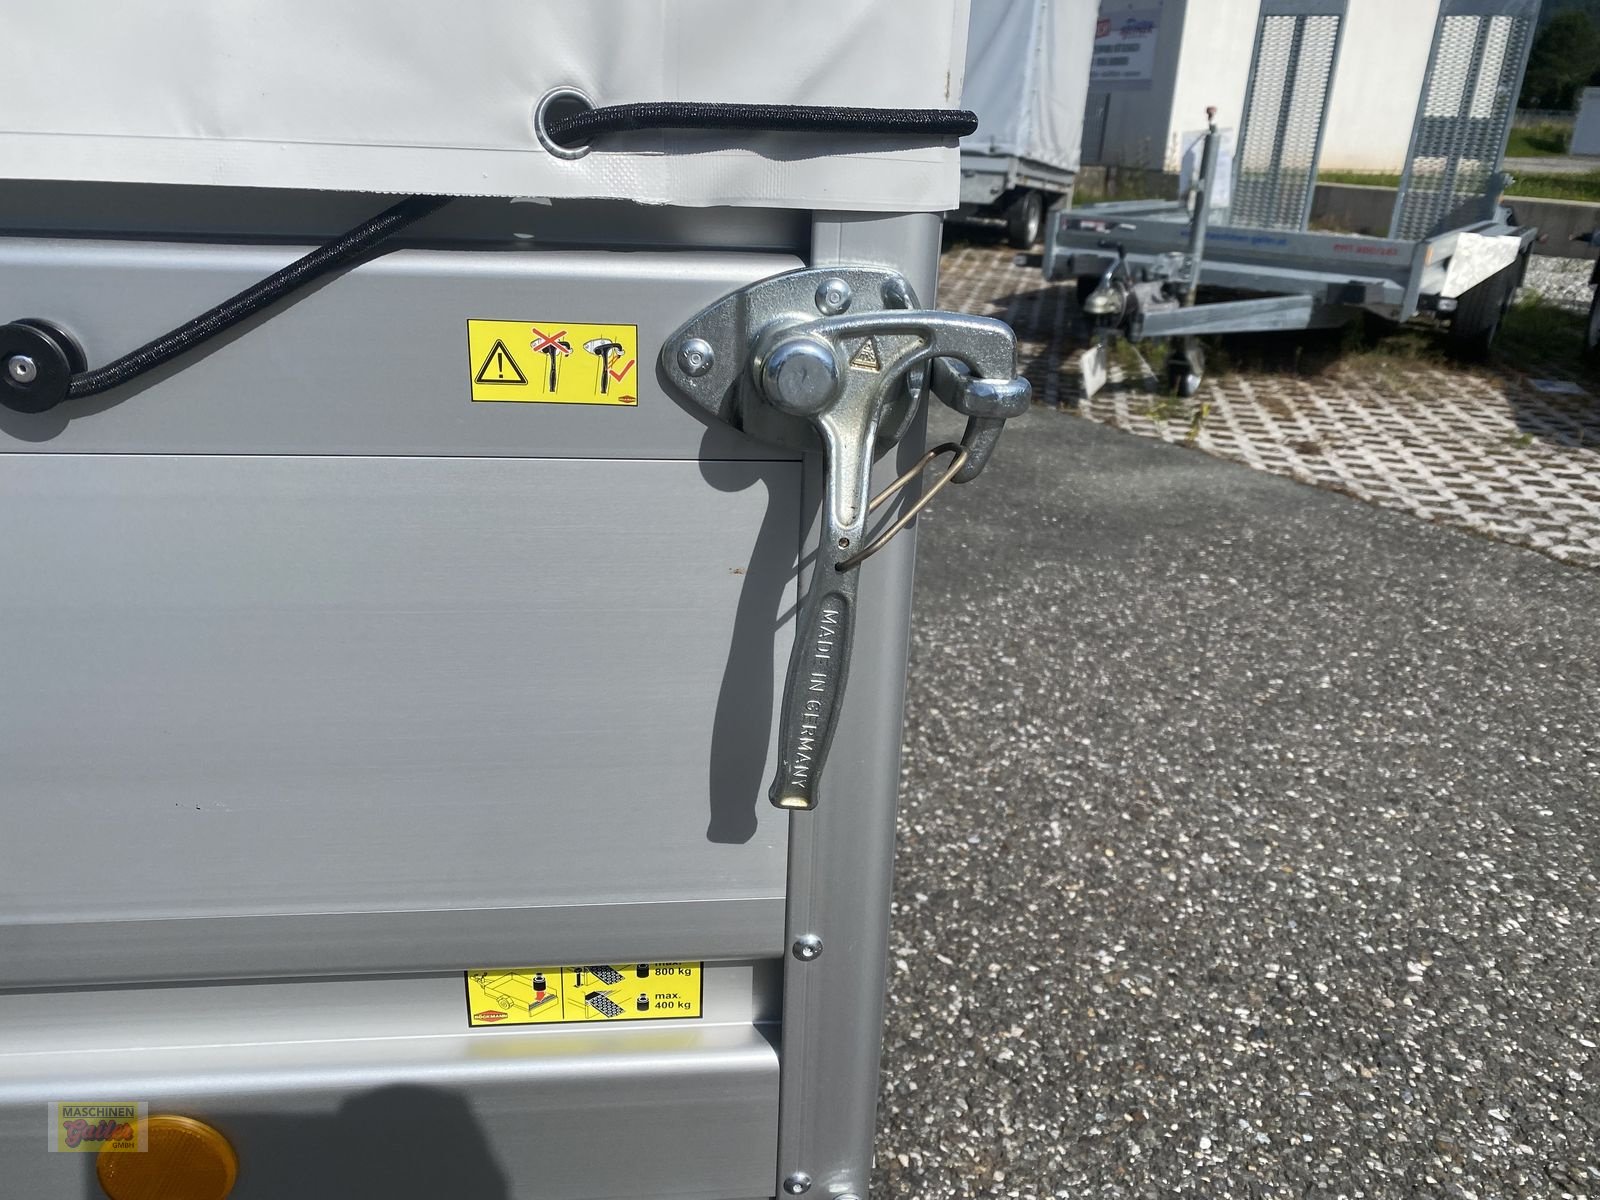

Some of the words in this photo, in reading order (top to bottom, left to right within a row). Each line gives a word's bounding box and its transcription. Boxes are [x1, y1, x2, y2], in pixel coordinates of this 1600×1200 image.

[815, 609, 839, 666] MADE
[809, 672, 827, 692] IN
[791, 699, 821, 789] GERMANY
[655, 967, 674, 976] 800
[678, 967, 691, 977] kg
[655, 992, 681, 1000] max.
[654, 1001, 674, 1009] 400
[678, 1001, 691, 1010] kg
